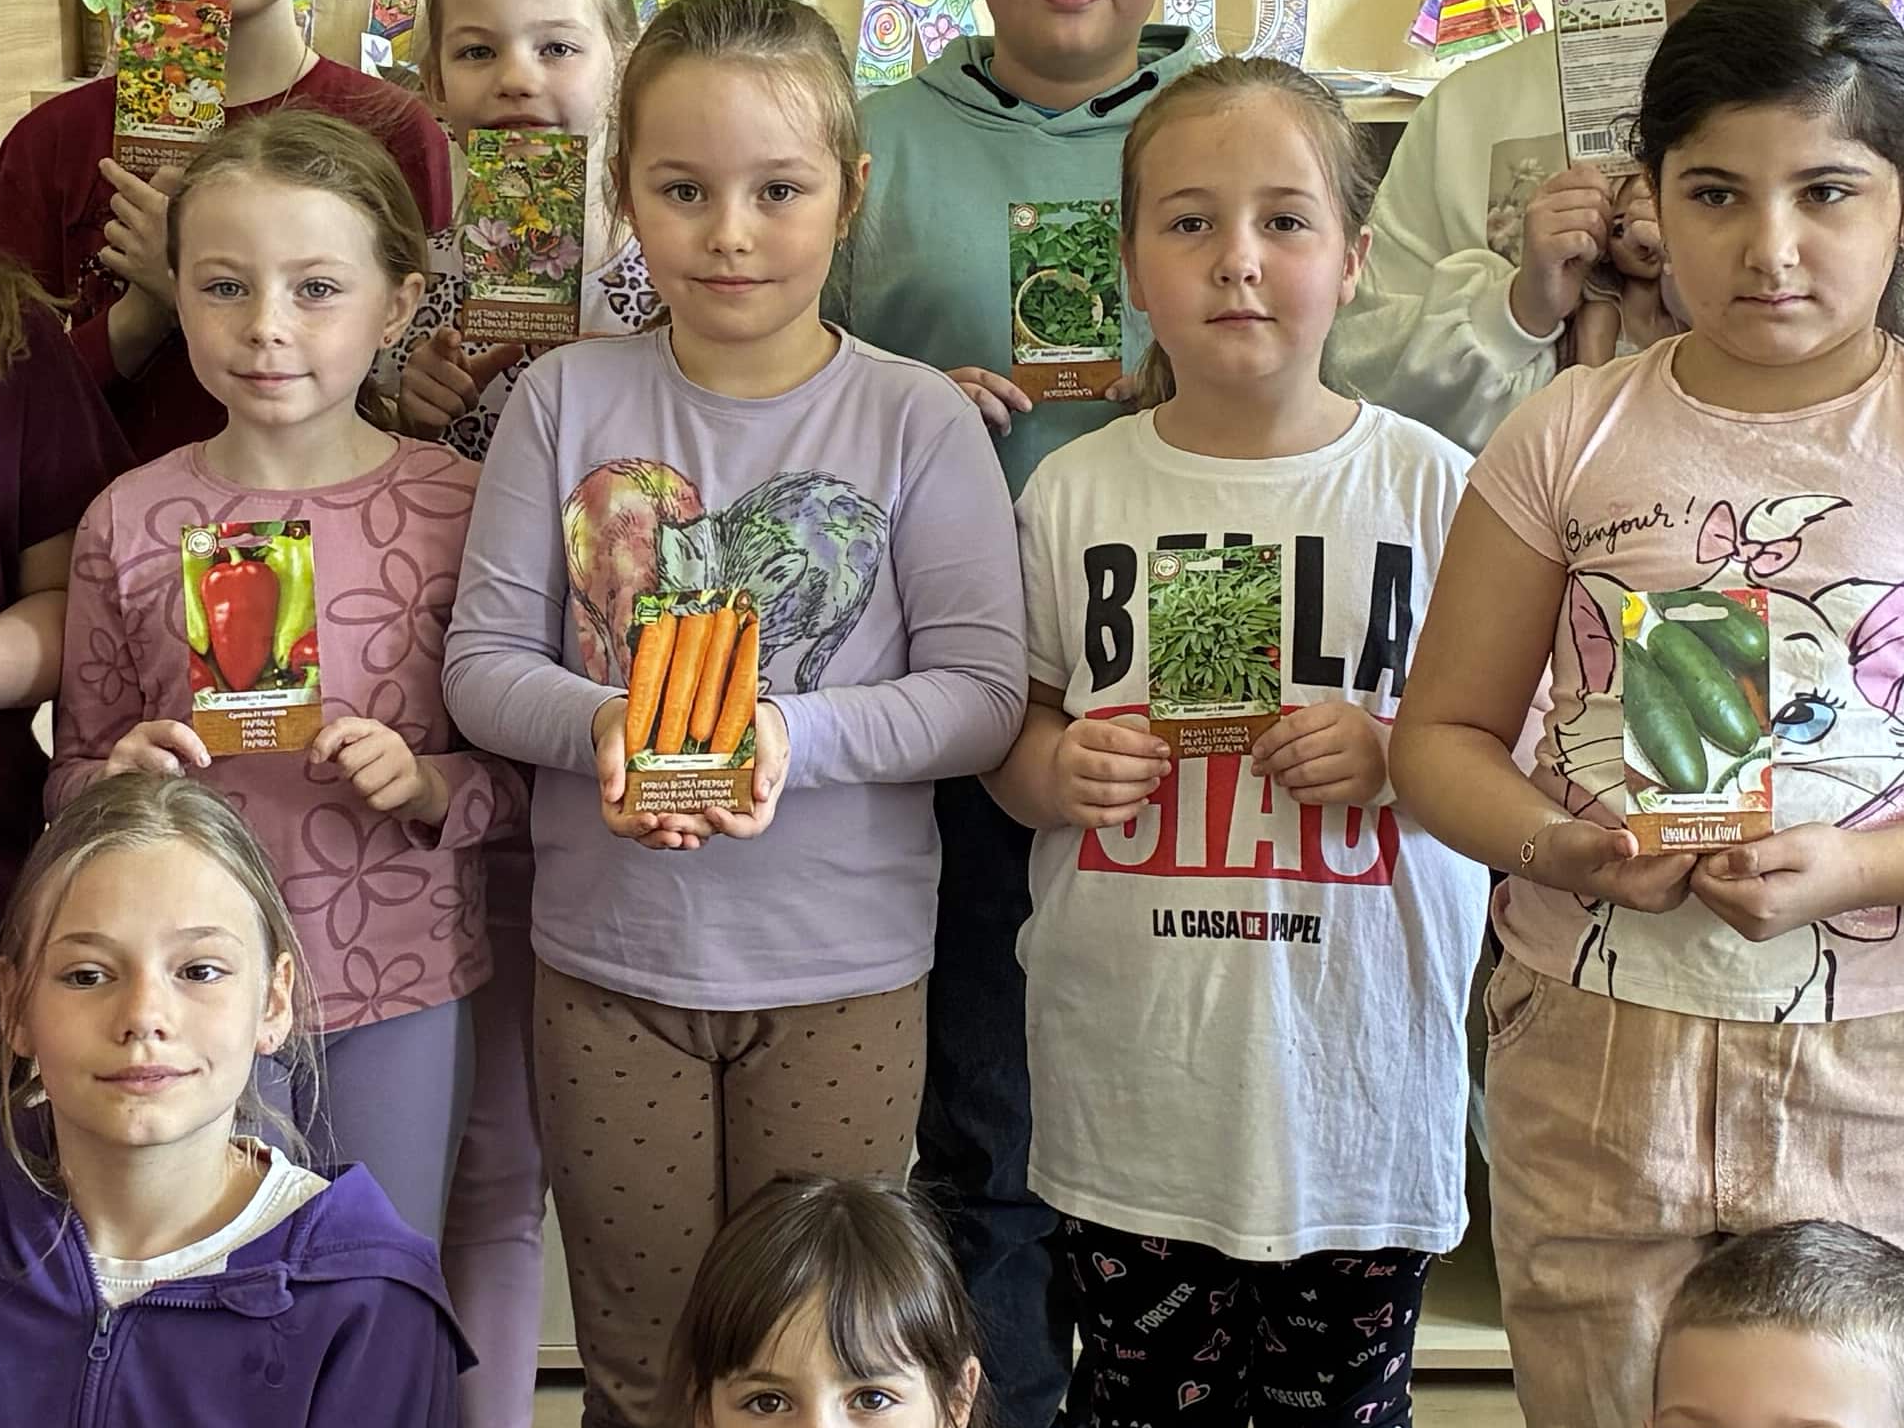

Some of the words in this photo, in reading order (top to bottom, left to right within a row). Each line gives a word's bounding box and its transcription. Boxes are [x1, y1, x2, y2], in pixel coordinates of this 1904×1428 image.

[1565, 504, 1675, 555] Bonjour
[1083, 532, 1413, 698] BLA
[1152, 909, 1177, 938] LA
[1182, 910, 1241, 940] CASA
[1247, 917, 1263, 936] DE
[1270, 913, 1322, 944] PAPEL
[1133, 1282, 1196, 1334] FOREVER
[1288, 1315, 1328, 1333] LOVE
[1348, 1342, 1388, 1368] LOVE
[1263, 1384, 1327, 1409] FOREVER
